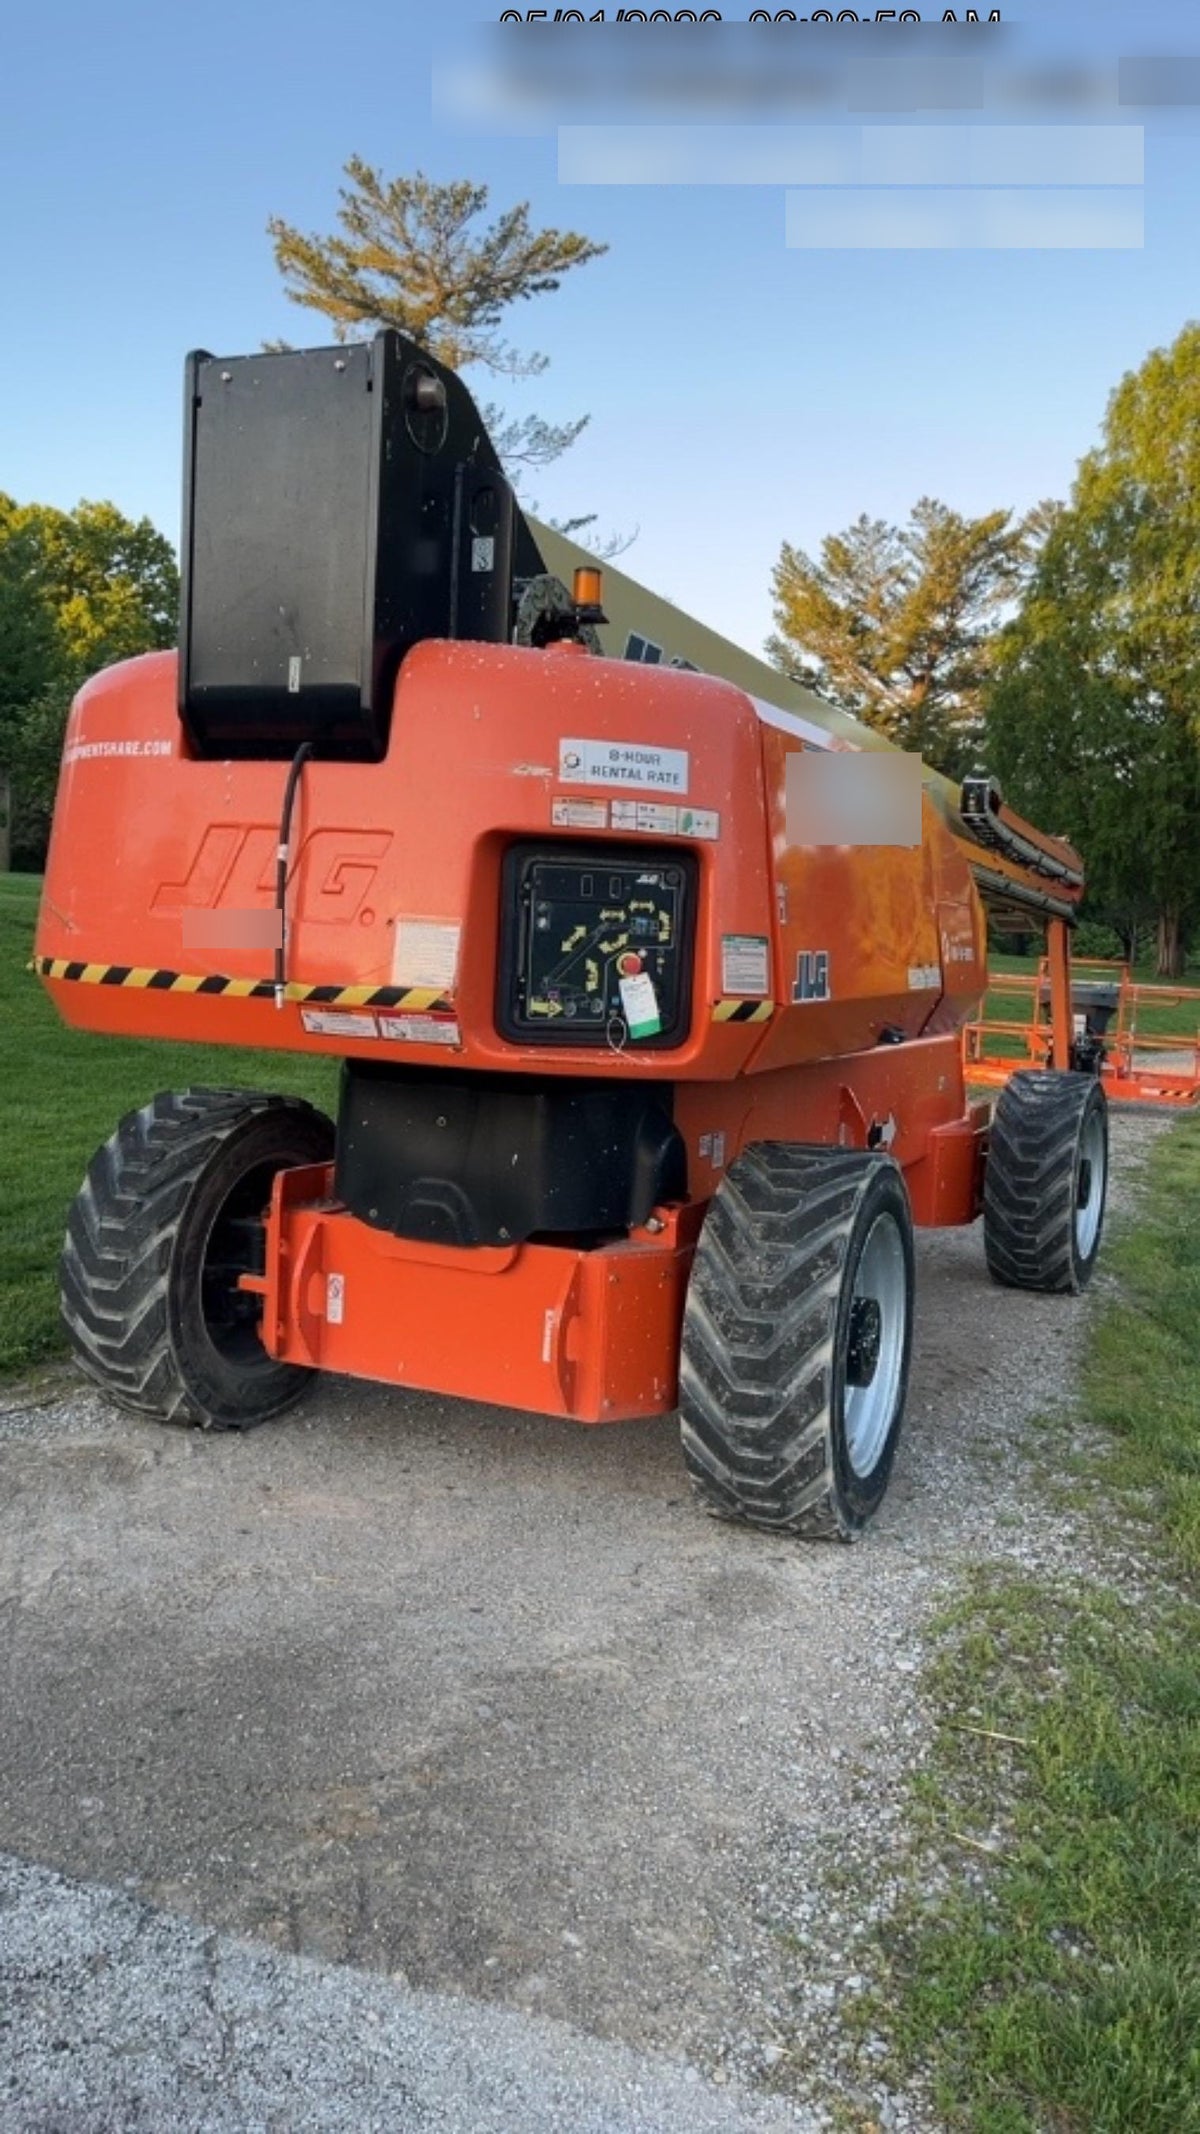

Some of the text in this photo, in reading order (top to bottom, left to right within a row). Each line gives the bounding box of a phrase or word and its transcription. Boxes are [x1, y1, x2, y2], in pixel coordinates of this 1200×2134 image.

[608, 748, 662, 767] 8-HOUR
[590, 764, 681, 786] RENTAL RATE
[790, 950, 832, 1004] JLG
